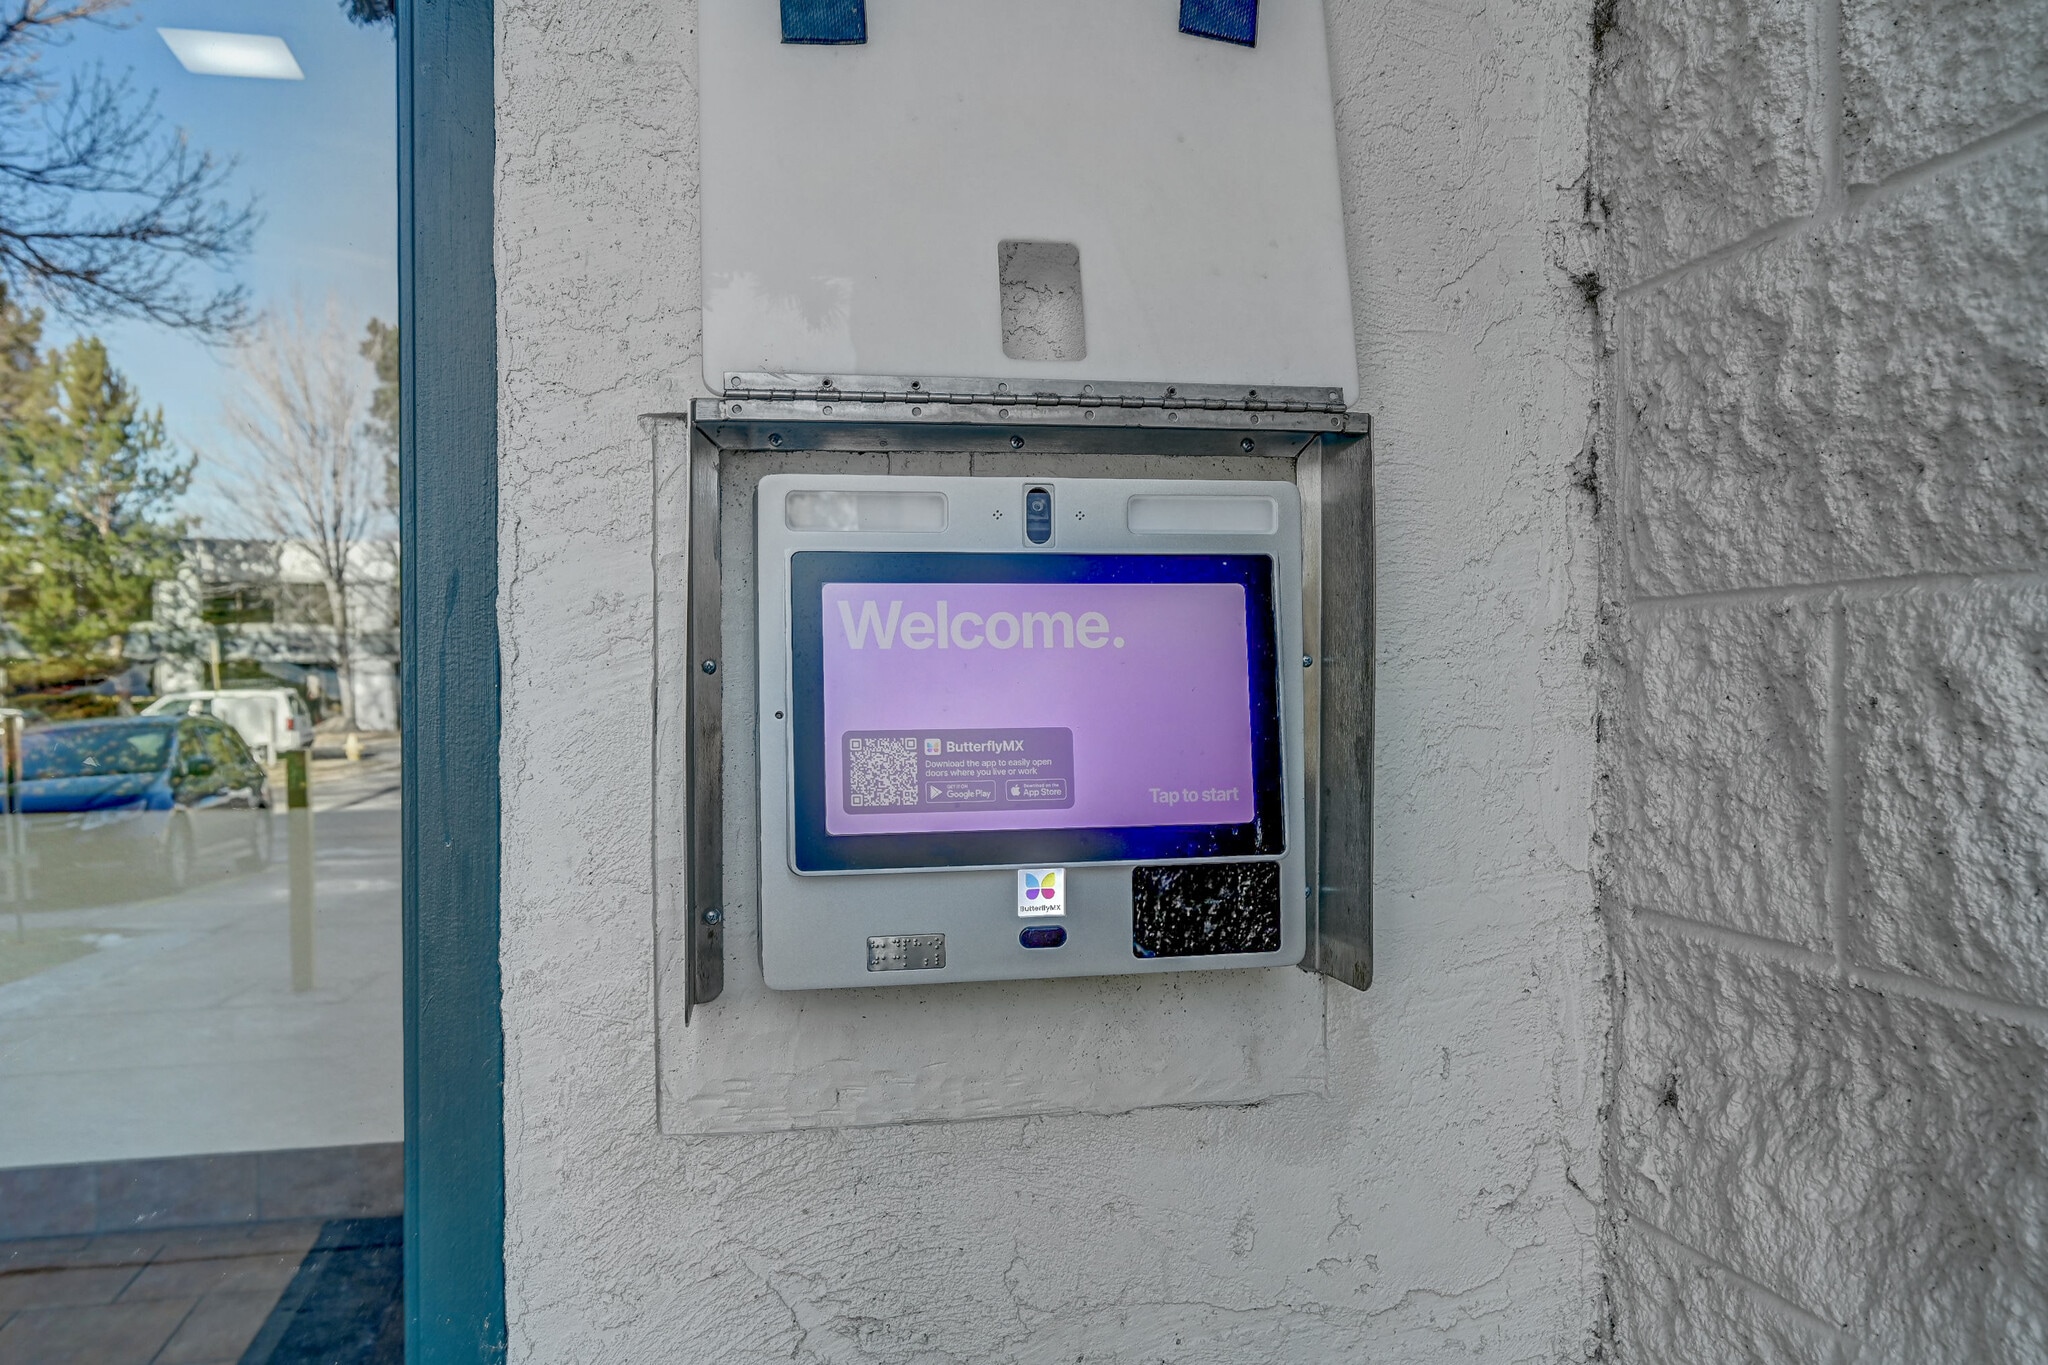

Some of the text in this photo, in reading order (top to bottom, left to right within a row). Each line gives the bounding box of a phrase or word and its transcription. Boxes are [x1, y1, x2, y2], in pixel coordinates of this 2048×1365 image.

[837, 600, 1126, 649] Welcome.
[946, 739, 1025, 754] ButterflyMX
[925, 760, 965, 768] Download
[1008, 758, 1031, 768] easily
[1032, 759, 1052, 767] open
[925, 769, 949, 777] doors
[950, 769, 975, 777] where
[976, 769, 991, 778] you
[992, 767, 1007, 776] live
[1017, 767, 1038, 775] work
[946, 789, 991, 800] Google Play
[1023, 788, 1062, 798] App Store
[1149, 787, 1240, 807] Tap to start
[1019, 904, 1061, 913] ButterflyMX
